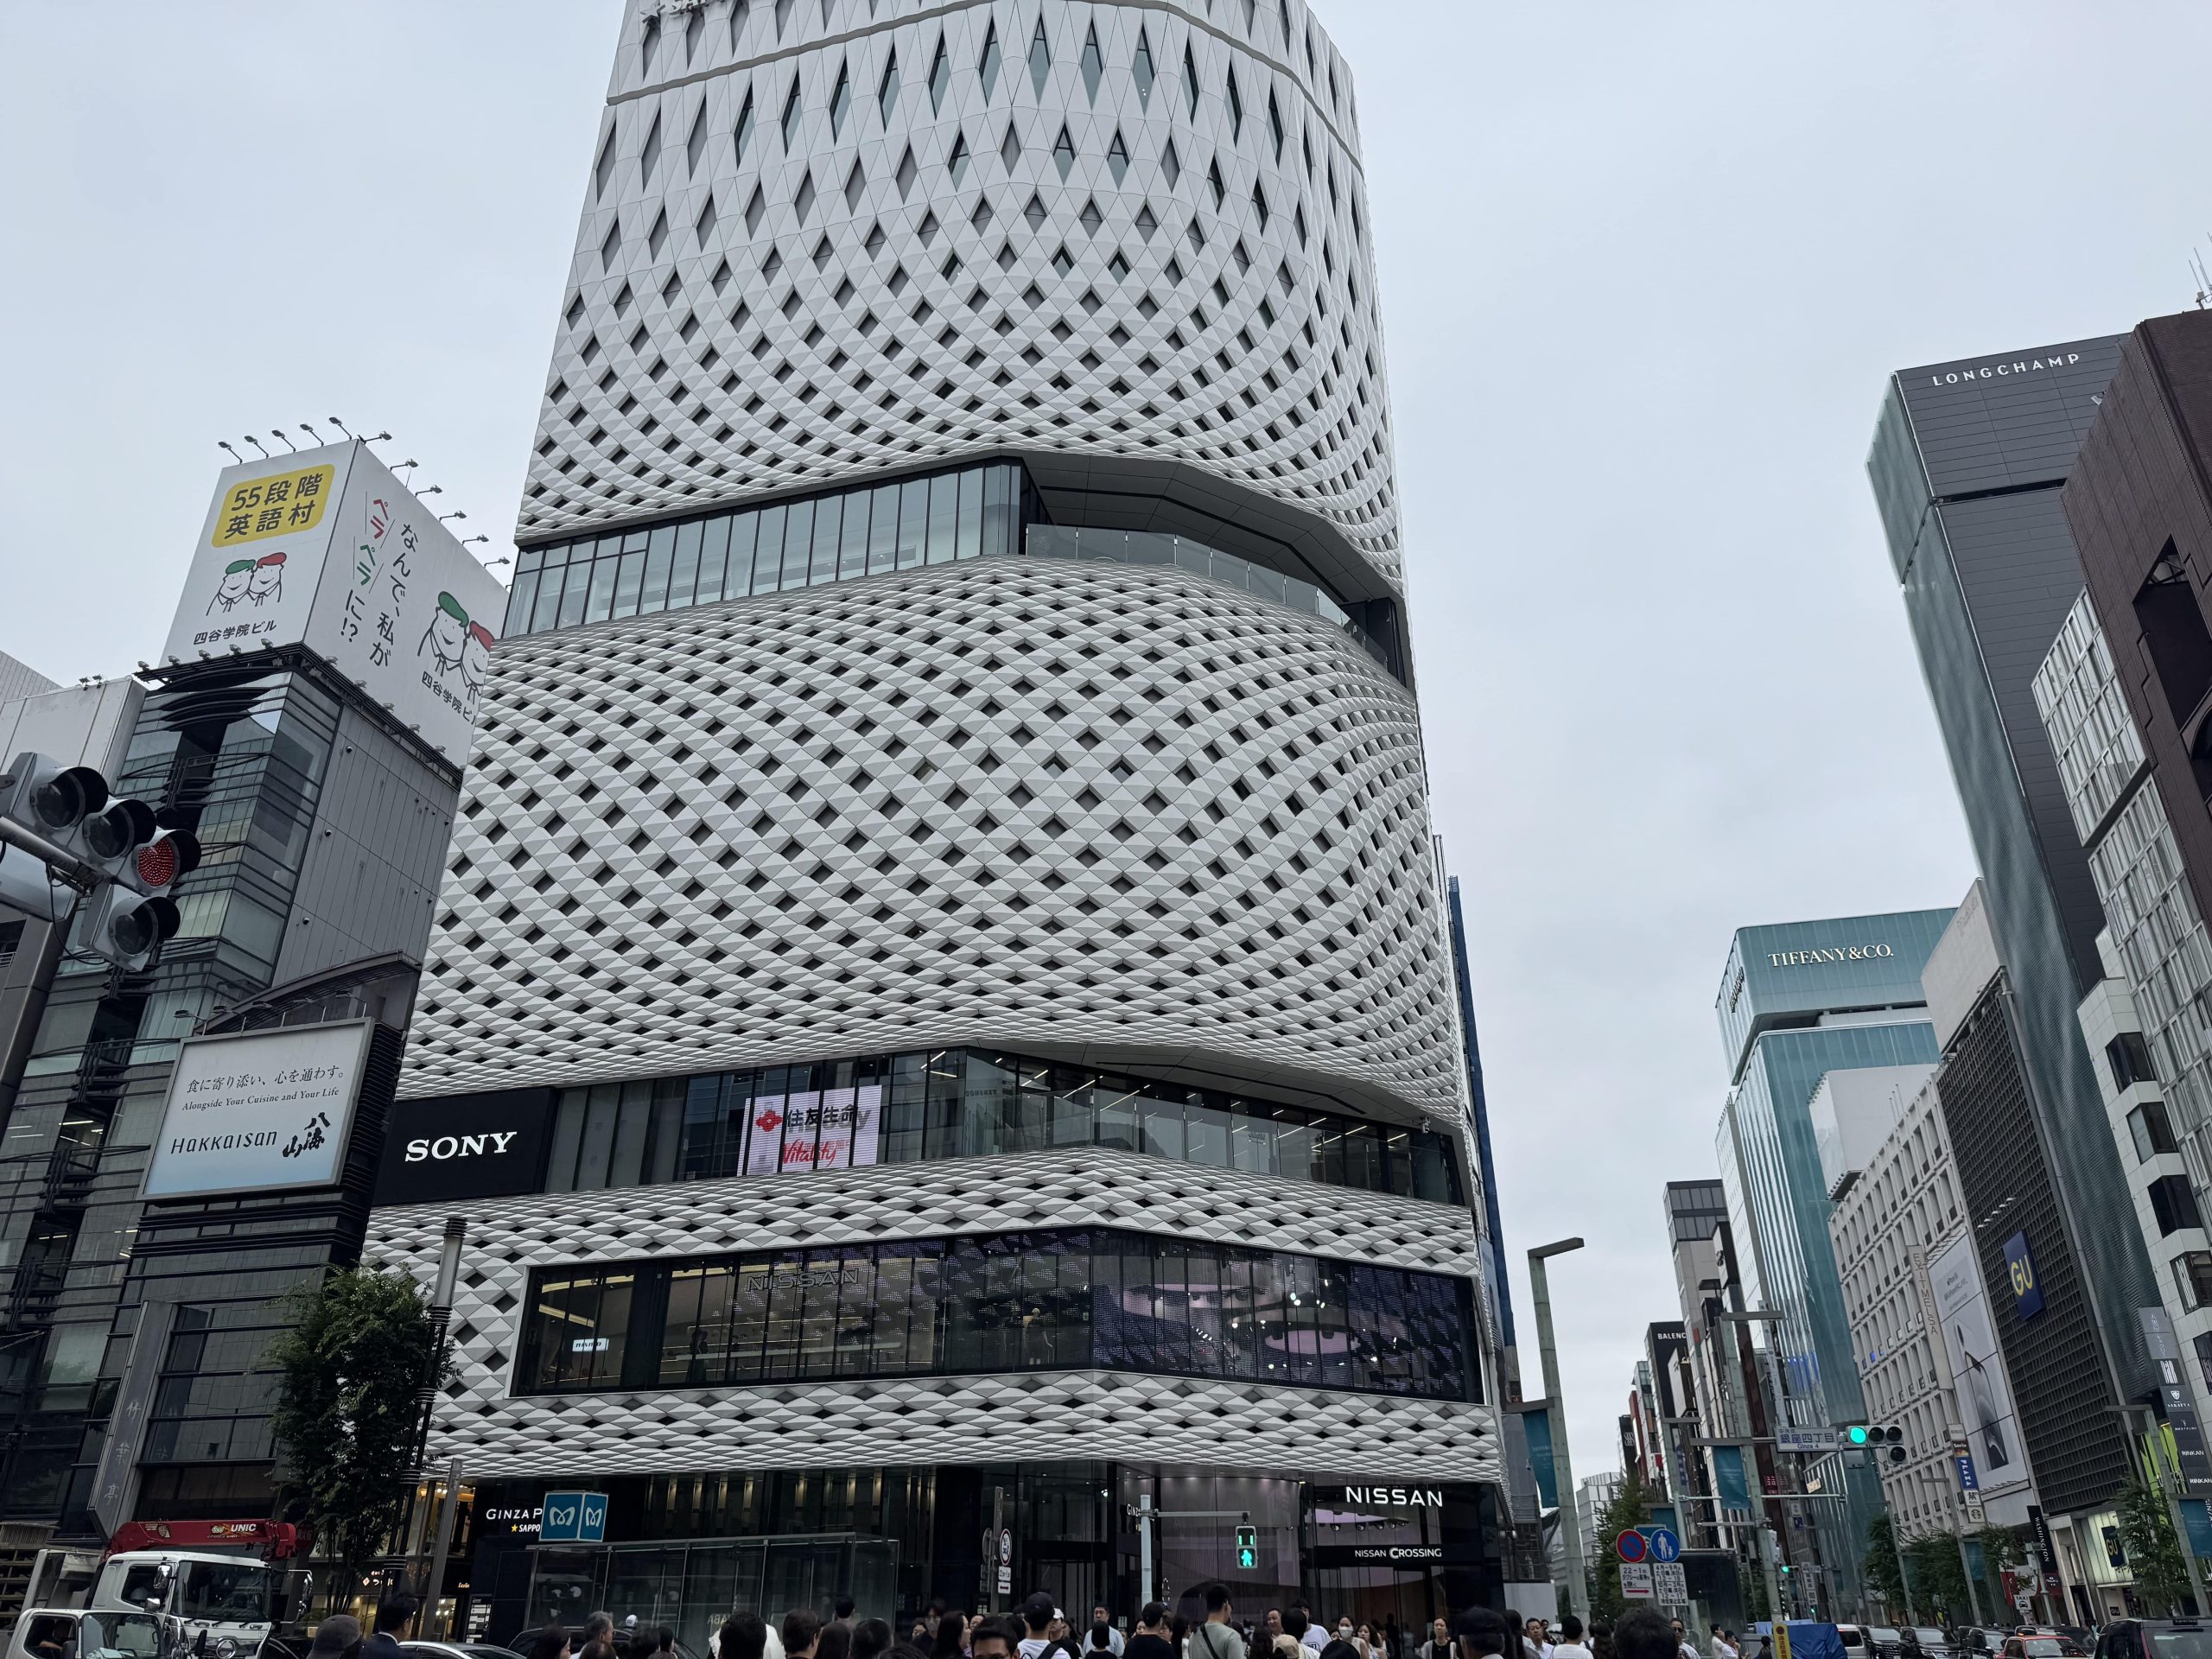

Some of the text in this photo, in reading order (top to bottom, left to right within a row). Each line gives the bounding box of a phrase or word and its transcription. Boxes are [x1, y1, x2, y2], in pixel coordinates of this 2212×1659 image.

[1932, 353, 2080, 386] LONGCHAMP
[232, 473, 323, 512] 55段階
[224, 500, 316, 539] 英語村
[369, 522, 419, 667] なんで、私が
[193, 619, 277, 645] 四谷学院ビル
[1767, 944, 1894, 967] TIFFANY&CO.
[181, 1087, 340, 1111] Alongside Your Cuisine and Your Life
[785, 1104, 855, 1128] 住友生命
[404, 1131, 518, 1162] SONY
[747, 1268, 860, 1292] NISSAN
[2011, 1255, 2033, 1296] GU
[1780, 1433, 1834, 1444] 銀座四丁目
[1960, 1459, 1972, 1486] PLAZA
[1345, 1486, 1443, 1507] NISSAN
[486, 1508, 530, 1520] GINZA
[231, 1523, 257, 1533] UNIC
[2034, 1516, 2050, 1562] WASHINGTON
[1355, 1547, 1442, 1560] NISSAN CROSSING
[2106, 1539, 2118, 1556] GU
